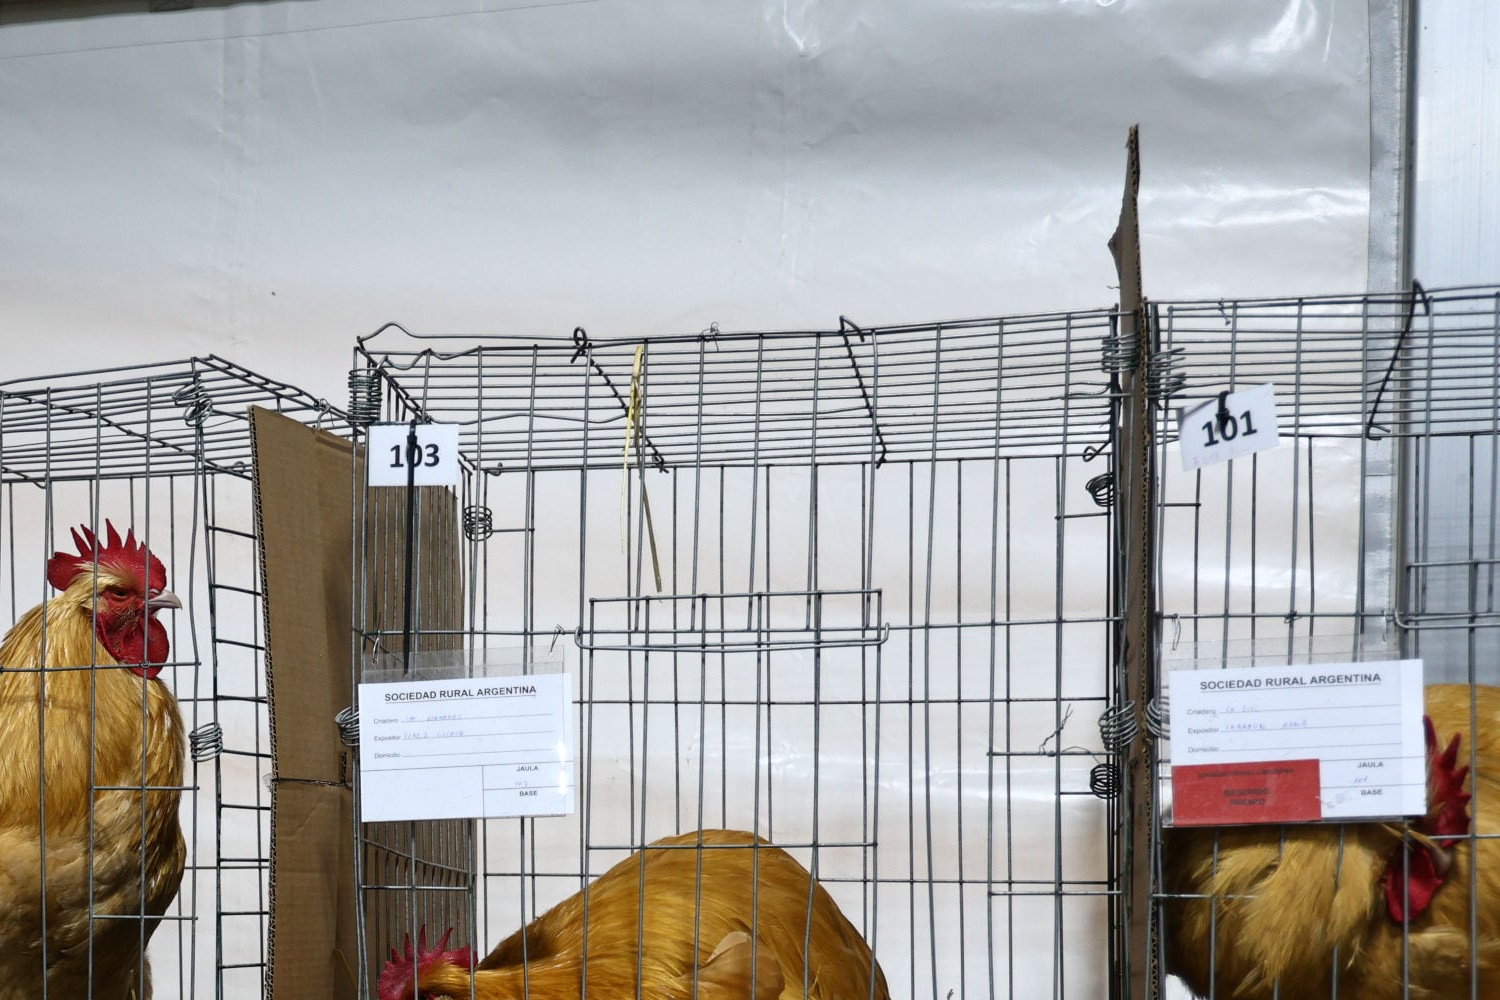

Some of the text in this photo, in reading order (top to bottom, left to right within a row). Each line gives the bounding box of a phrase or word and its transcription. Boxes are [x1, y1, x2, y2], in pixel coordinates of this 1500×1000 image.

[1202, 410, 1257, 447] 101
[389, 443, 440, 468] 103
[1200, 673, 1381, 690] SOCIEDAD RURAL ARGENTINA
[384, 685, 536, 702] SOCIEDAD RURAL ARGENTINA
